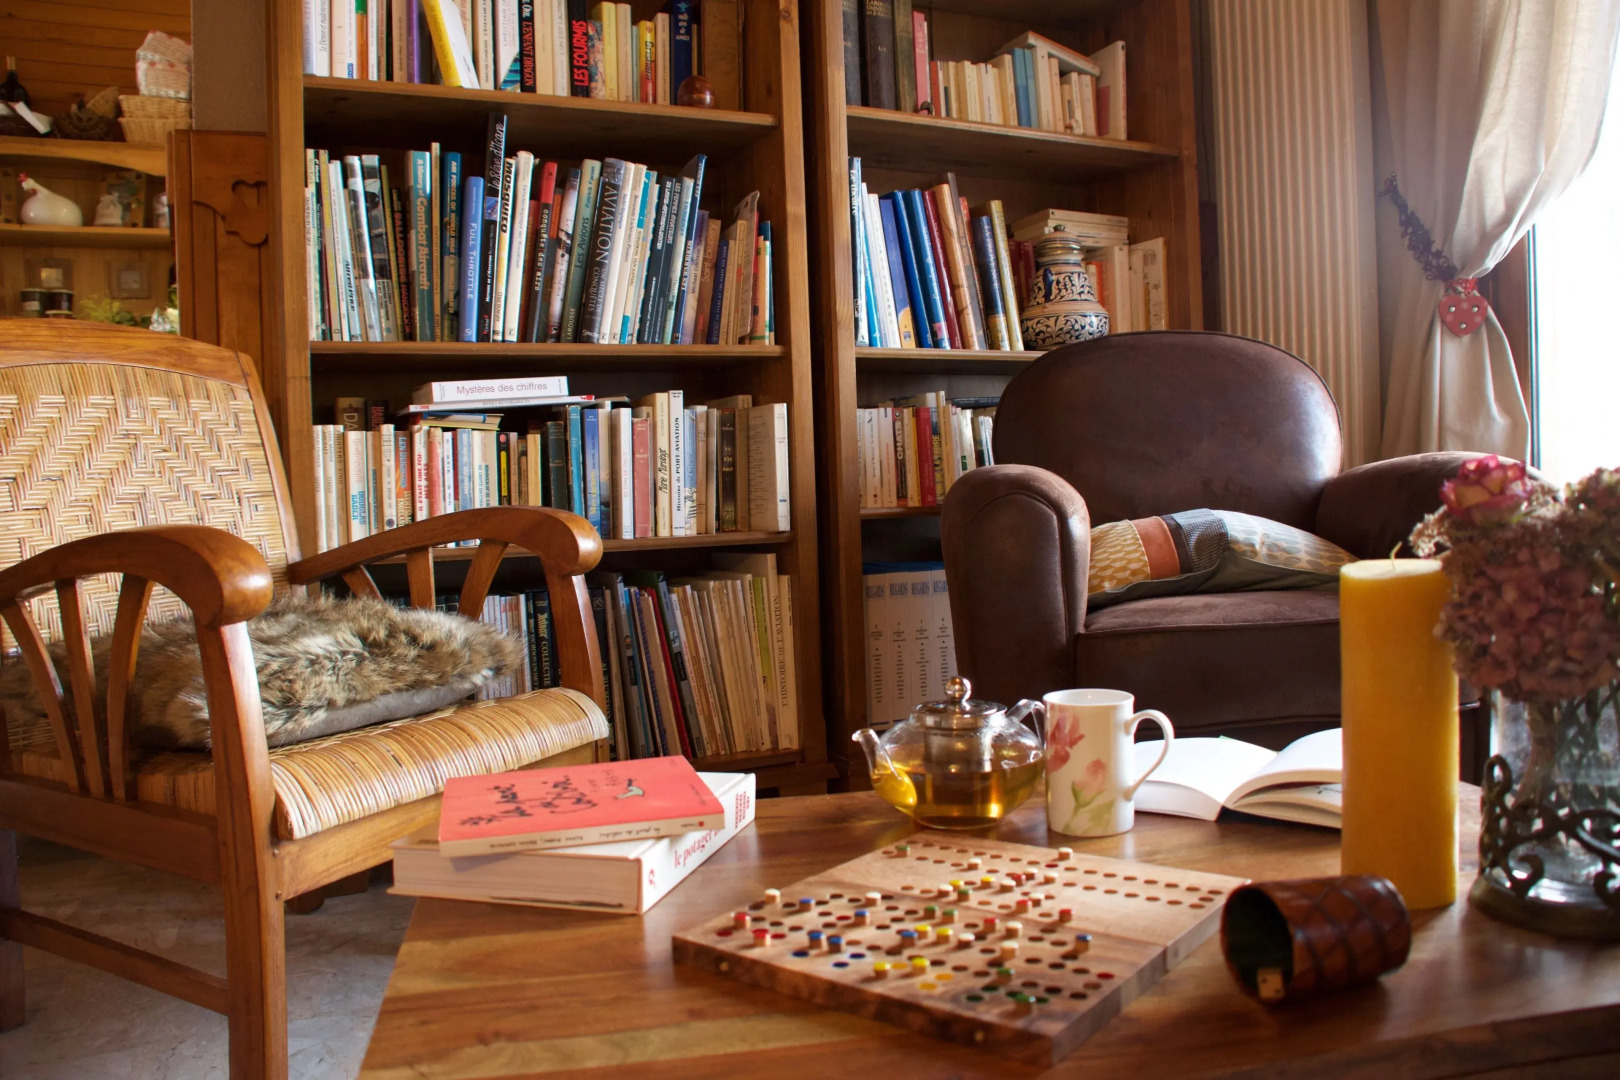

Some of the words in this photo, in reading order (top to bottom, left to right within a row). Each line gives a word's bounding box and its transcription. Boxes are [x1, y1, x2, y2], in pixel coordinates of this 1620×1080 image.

[572, 20, 588, 67] FOURMIS
[644, 41, 654, 80] Grisham
[523, 56, 534, 87] DRAGON
[573, 68, 589, 86] LES
[417, 197, 428, 244] Combat
[671, 192, 680, 214] FEMMES
[469, 222, 478, 247] FULL
[538, 208, 549, 248] conquête
[577, 216, 589, 251] Avions
[595, 185, 618, 263] AVIATION
[418, 245, 430, 290] Aircraft
[467, 251, 476, 300] THROTTLE
[537, 252, 545, 267] des
[575, 252, 584, 268] Les
[534, 271, 543, 291] airs
[566, 307, 576, 340] LAROUSSE
[456, 385, 495, 396] Mystères
[498, 383, 514, 392] des
[516, 382, 548, 391] chiffres
[398, 437, 406, 450] LEN
[894, 421, 904, 460] CHATS
[351, 494, 359, 521] BADER
[358, 491, 366, 526] DOUGLAS
[773, 595, 783, 643] L'AVIATION
[541, 641, 550, 686] COLLECTIE
[778, 657, 789, 707] L'HISTOIRE
[674, 850, 682, 868] le
[683, 828, 714, 867] potager
